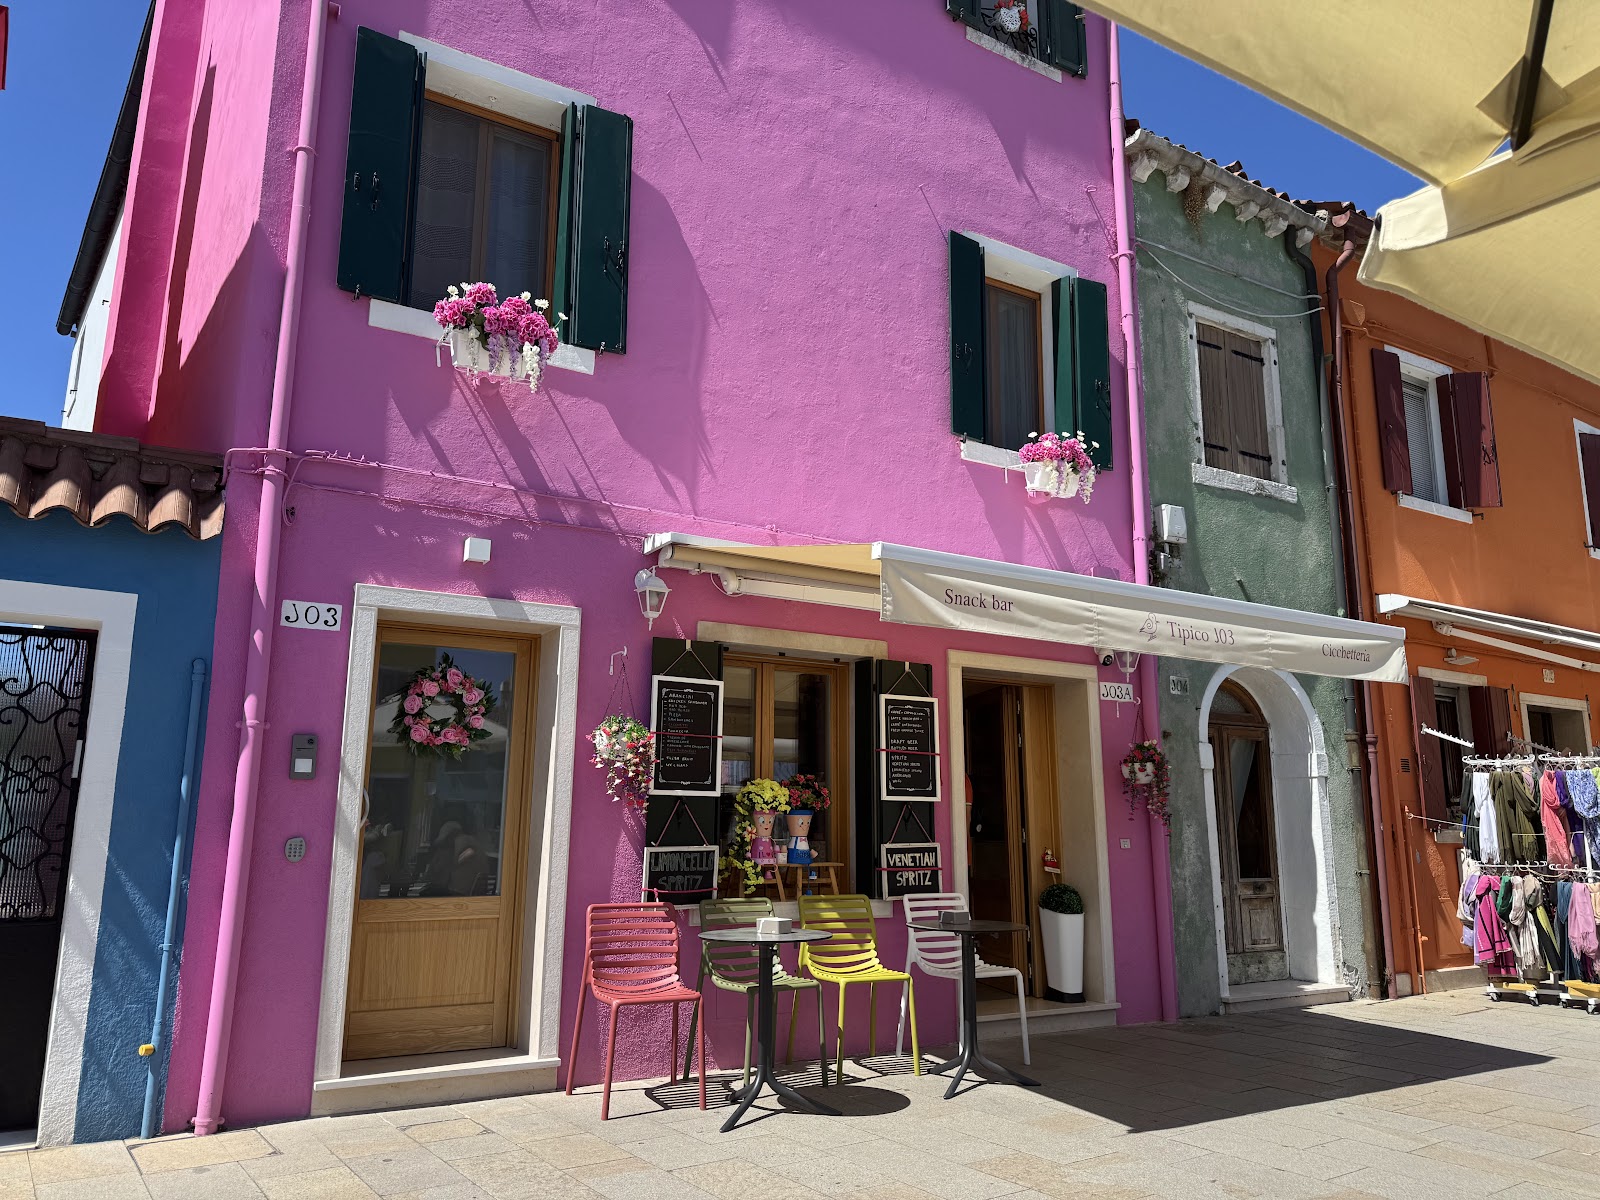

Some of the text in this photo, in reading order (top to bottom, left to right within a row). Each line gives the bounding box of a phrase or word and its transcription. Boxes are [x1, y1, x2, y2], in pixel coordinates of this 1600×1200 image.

[944, 588, 1014, 612] Snack bar
[1166, 620, 1209, 646] Tipico
[1321, 643, 1371, 662] Cicchetteria
[650, 851, 716, 872] LIMONCELLO
[887, 852, 936, 867] VENETIAN
[658, 874, 704, 890] SPRITZ
[896, 870, 932, 887] SPRITZ
